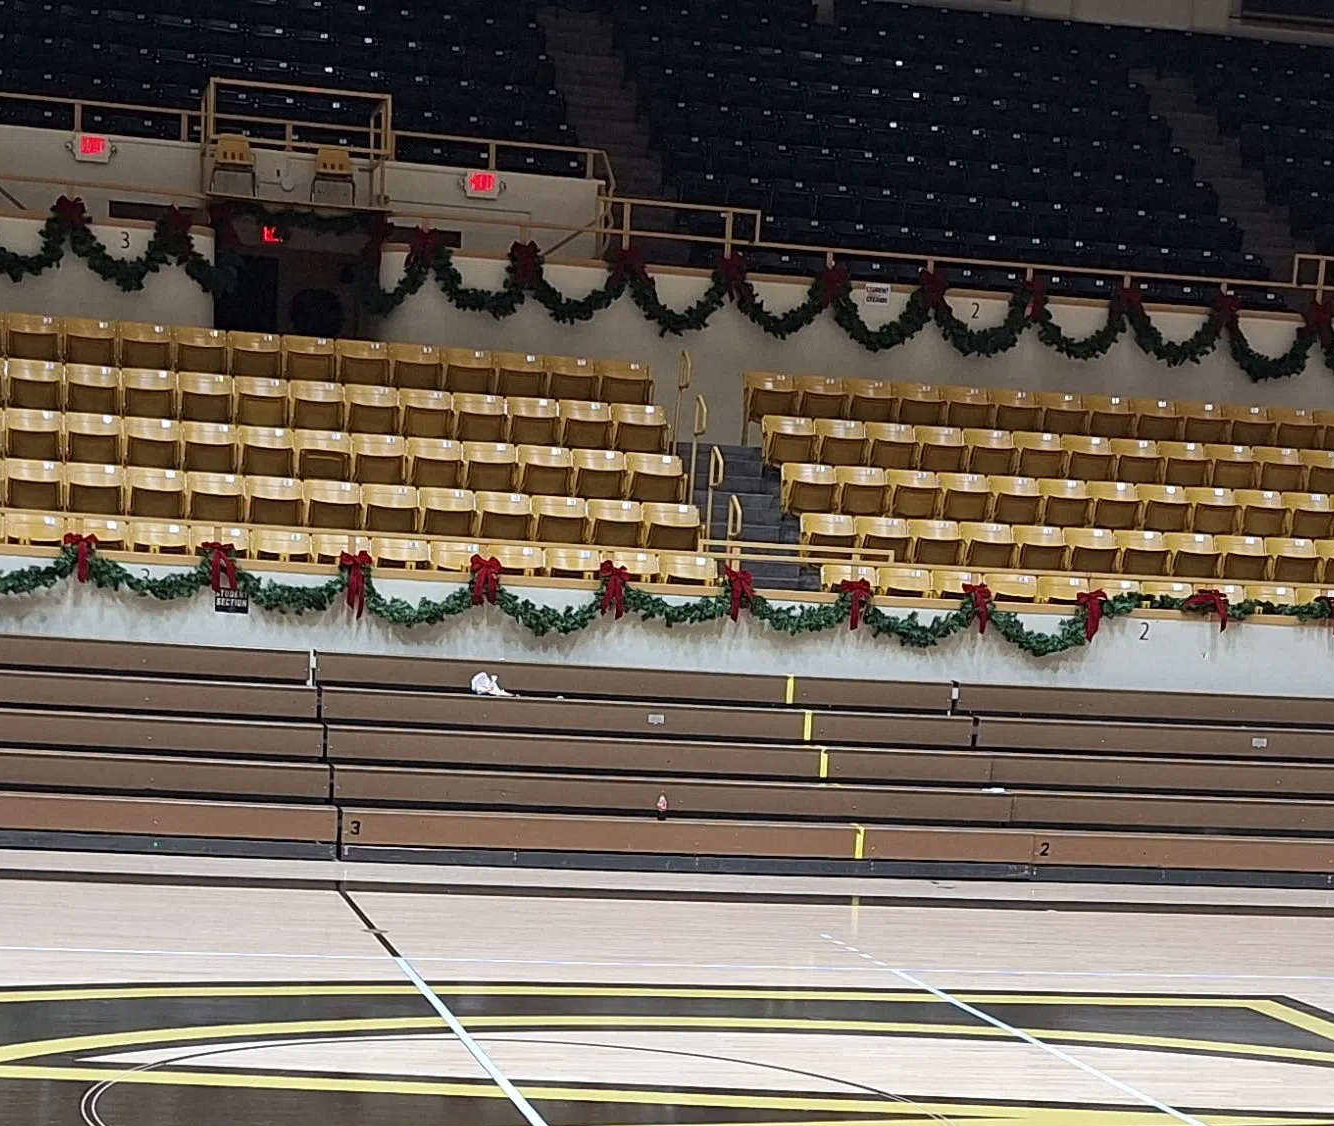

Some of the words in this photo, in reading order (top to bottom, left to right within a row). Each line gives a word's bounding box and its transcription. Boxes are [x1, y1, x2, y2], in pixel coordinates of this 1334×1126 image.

[120, 231, 131, 249] 3
[970, 302, 980, 319] 2
[215, 597, 248, 608] SECTION
[1138, 621, 1150, 641] 2
[349, 820, 361, 836] 3
[1038, 840, 1050, 857] 2
